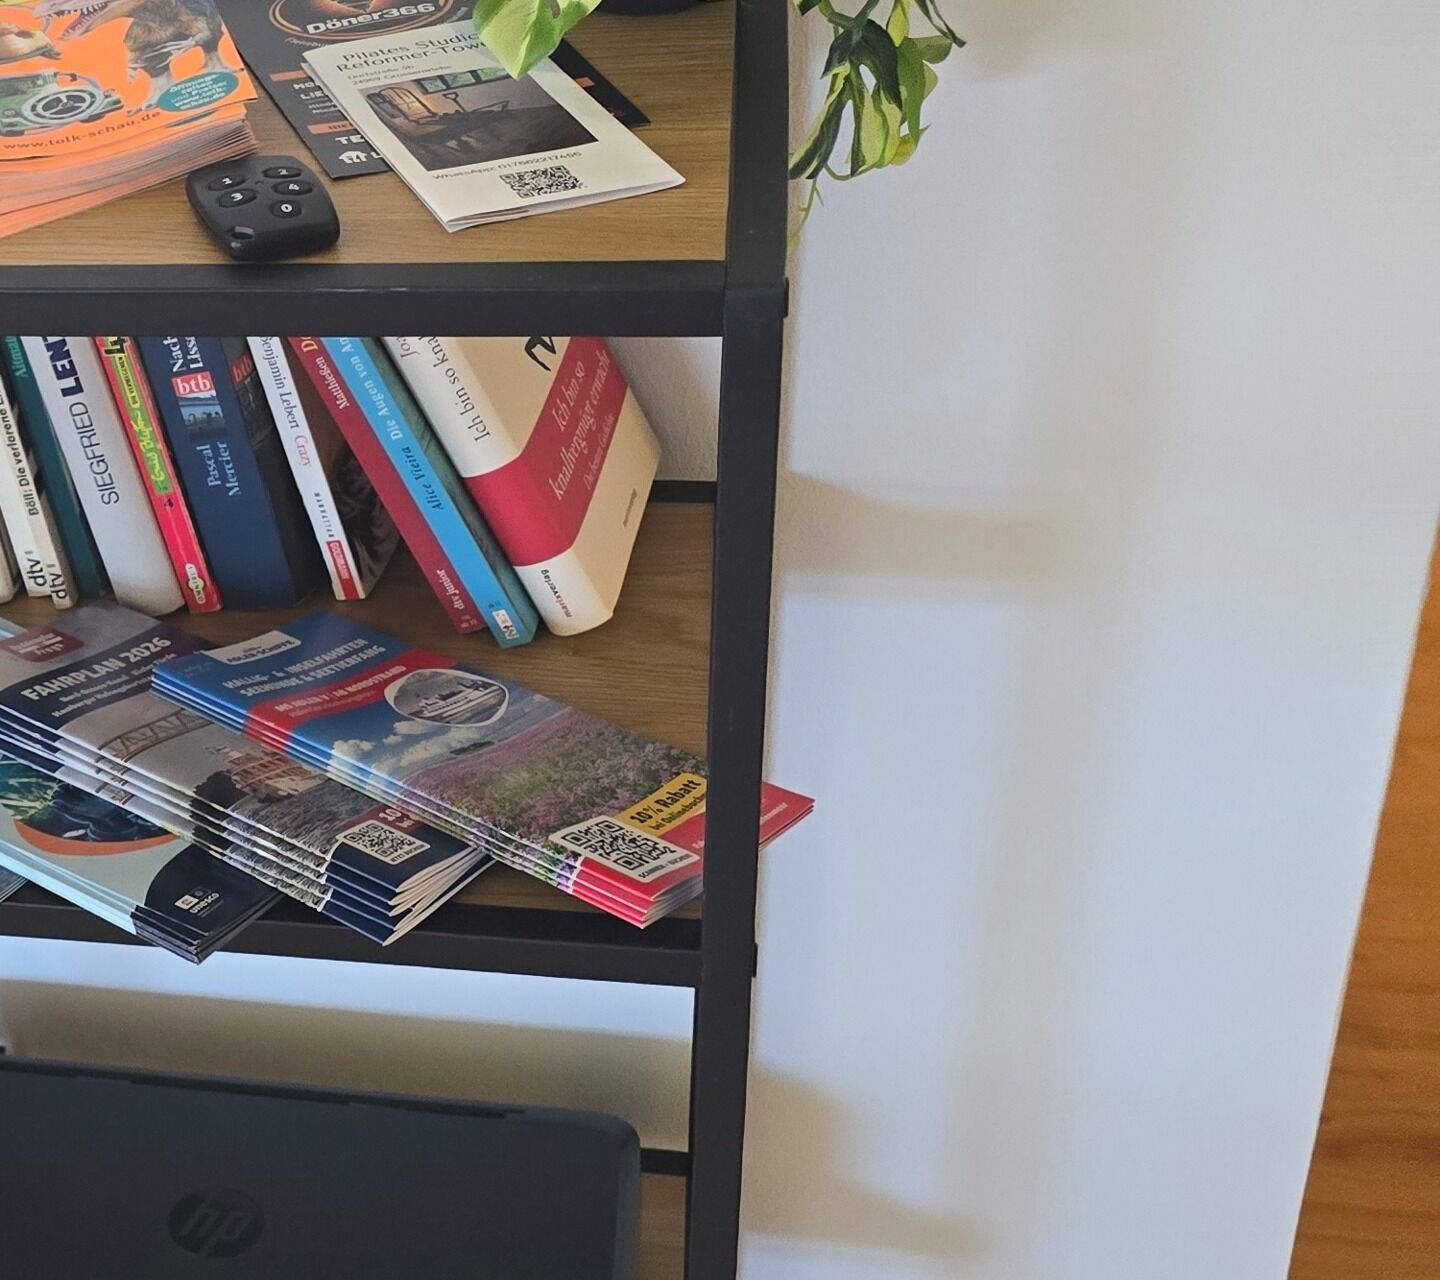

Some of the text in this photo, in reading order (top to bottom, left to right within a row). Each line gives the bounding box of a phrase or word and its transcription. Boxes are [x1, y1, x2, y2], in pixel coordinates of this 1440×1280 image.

[307, 3, 436, 34] Döner366
[344, 44, 404, 63] Pilates
[3, 111, 160, 150] www.tolk-schau.de
[176, 375, 211, 395] btb
[351, 355, 403, 441] Die Augen von
[445, 367, 491, 443] Ich bin so
[0, 407, 25, 468] verlorene
[130, 410, 155, 451] Blyton
[279, 391, 299, 430] Lebert
[294, 435, 312, 468] Crazy
[68, 401, 120, 506] SIEGFRIED
[196, 443, 221, 487] Pascal
[216, 440, 242, 497] Mercier
[15, 468, 30, 488] Die
[402, 445, 445, 510] Alice Vieira
[24, 489, 41, 517] Böll:
[27, 557, 48, 588] dtv
[437, 568, 462, 601] junior
[541, 568, 574, 620] marixverlag
[21, 657, 127, 701] FAHRPLAN
[119, 636, 173, 663] 2026
[239, 676, 304, 697] SEEHUNDE
[309, 643, 387, 681] SEETIERFANG
[284, 637, 370, 674] INSELFAHRTEN
[654, 778, 703, 810] Rabatt
[648, 817, 667, 832] bei
[182, 1198, 253, 1257] hp
